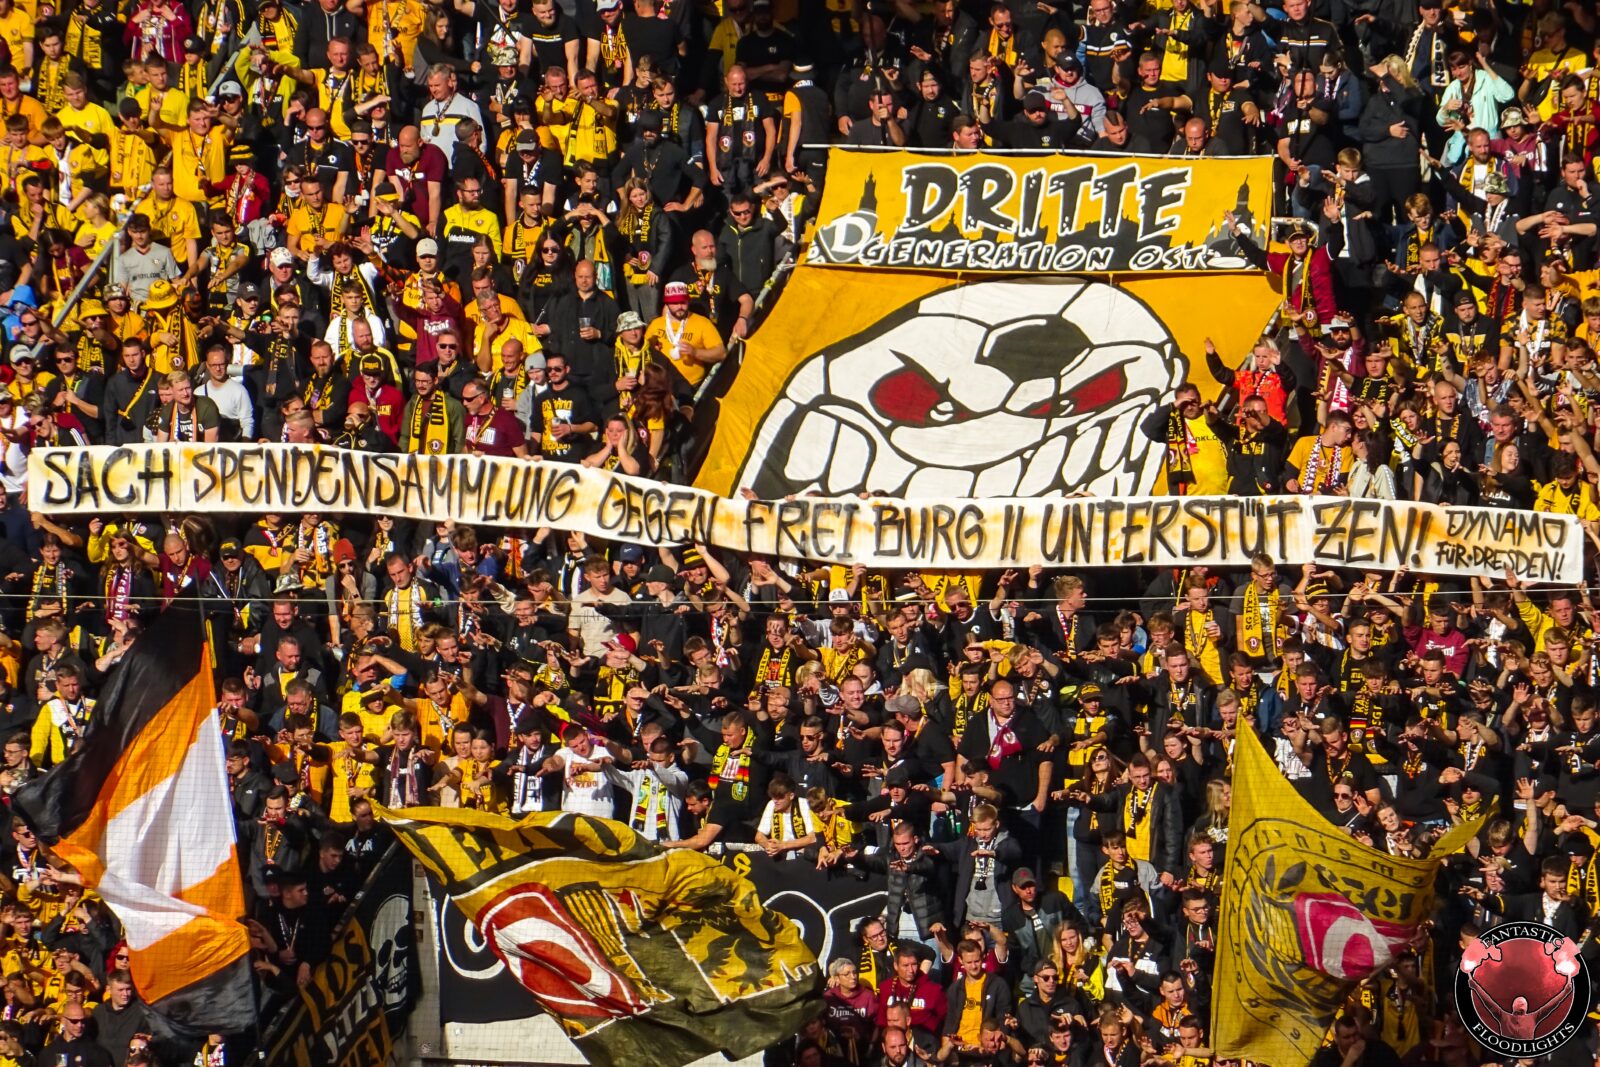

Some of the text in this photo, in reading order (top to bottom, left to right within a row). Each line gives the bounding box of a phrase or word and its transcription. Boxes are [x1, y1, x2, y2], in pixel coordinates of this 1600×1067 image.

[901, 162, 1192, 241] DRITTE
[859, 237, 1114, 271] GENERATION
[43, 447, 173, 509] SACH
[191, 445, 580, 523] SPENDENSAMMLUNG
[597, 475, 720, 546] GEGEN
[743, 499, 859, 559] FREI
[873, 499, 985, 563] BURG
[1312, 499, 1432, 567] ZEN!
[1445, 508, 1567, 549] DYNAMO
